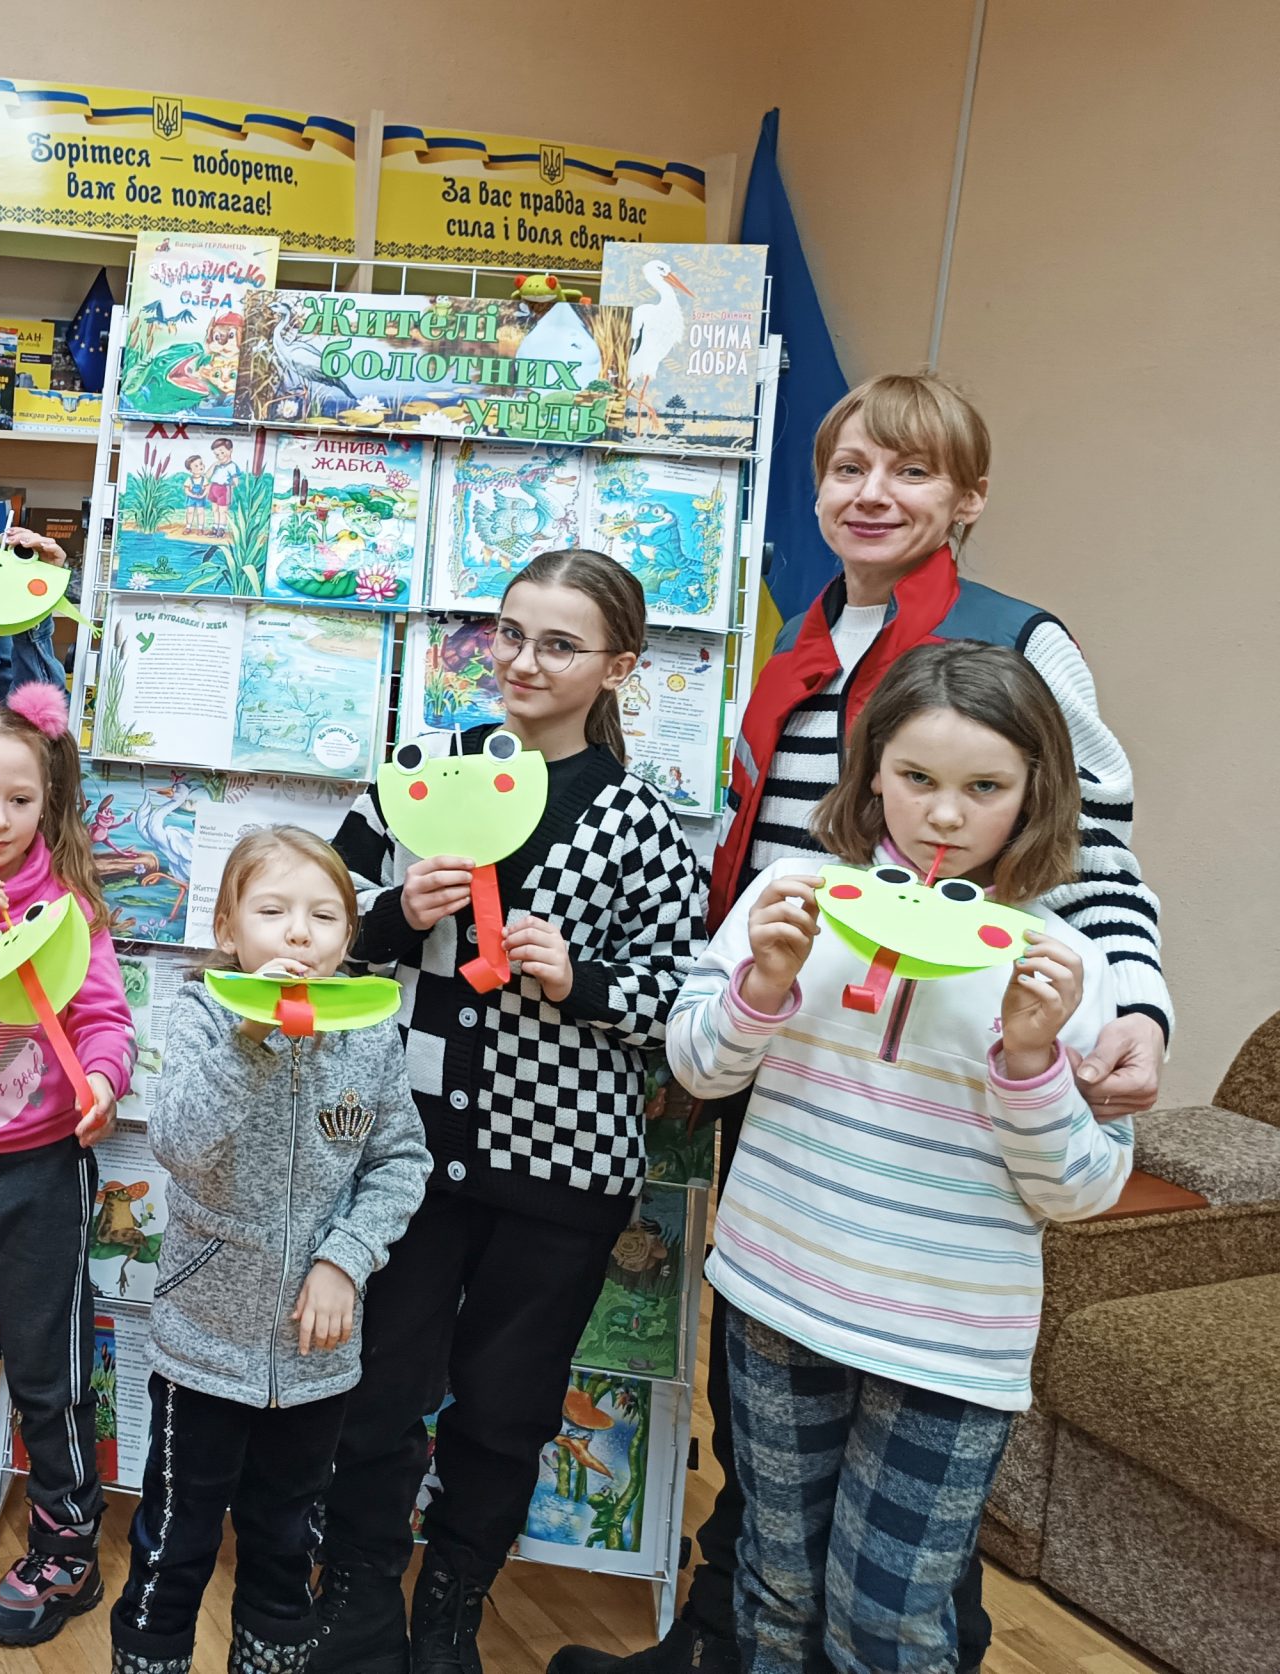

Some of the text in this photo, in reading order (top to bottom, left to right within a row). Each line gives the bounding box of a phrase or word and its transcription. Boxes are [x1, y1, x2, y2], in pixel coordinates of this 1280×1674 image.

[27, 132, 151, 168] Борітеся
[193, 149, 298, 187] поборете,
[67, 172, 272, 216] вам бог помагає!
[442, 176, 647, 225] За вас правда за вас
[447, 218, 495, 239] сила
[504, 217, 510, 240] і
[517, 218, 563, 246] воля
[300, 296, 499, 343] Жителі
[689, 324, 752, 350] ОЧИМА
[320, 338, 582, 391] болотних
[686, 349, 748, 376] ДОБРА
[463, 391, 607, 442] угідь
[311, 457, 388, 474] ЖАБКА
[313, 439, 389, 457] ЛІНИВА
[13, 1051, 41, 1100] good
